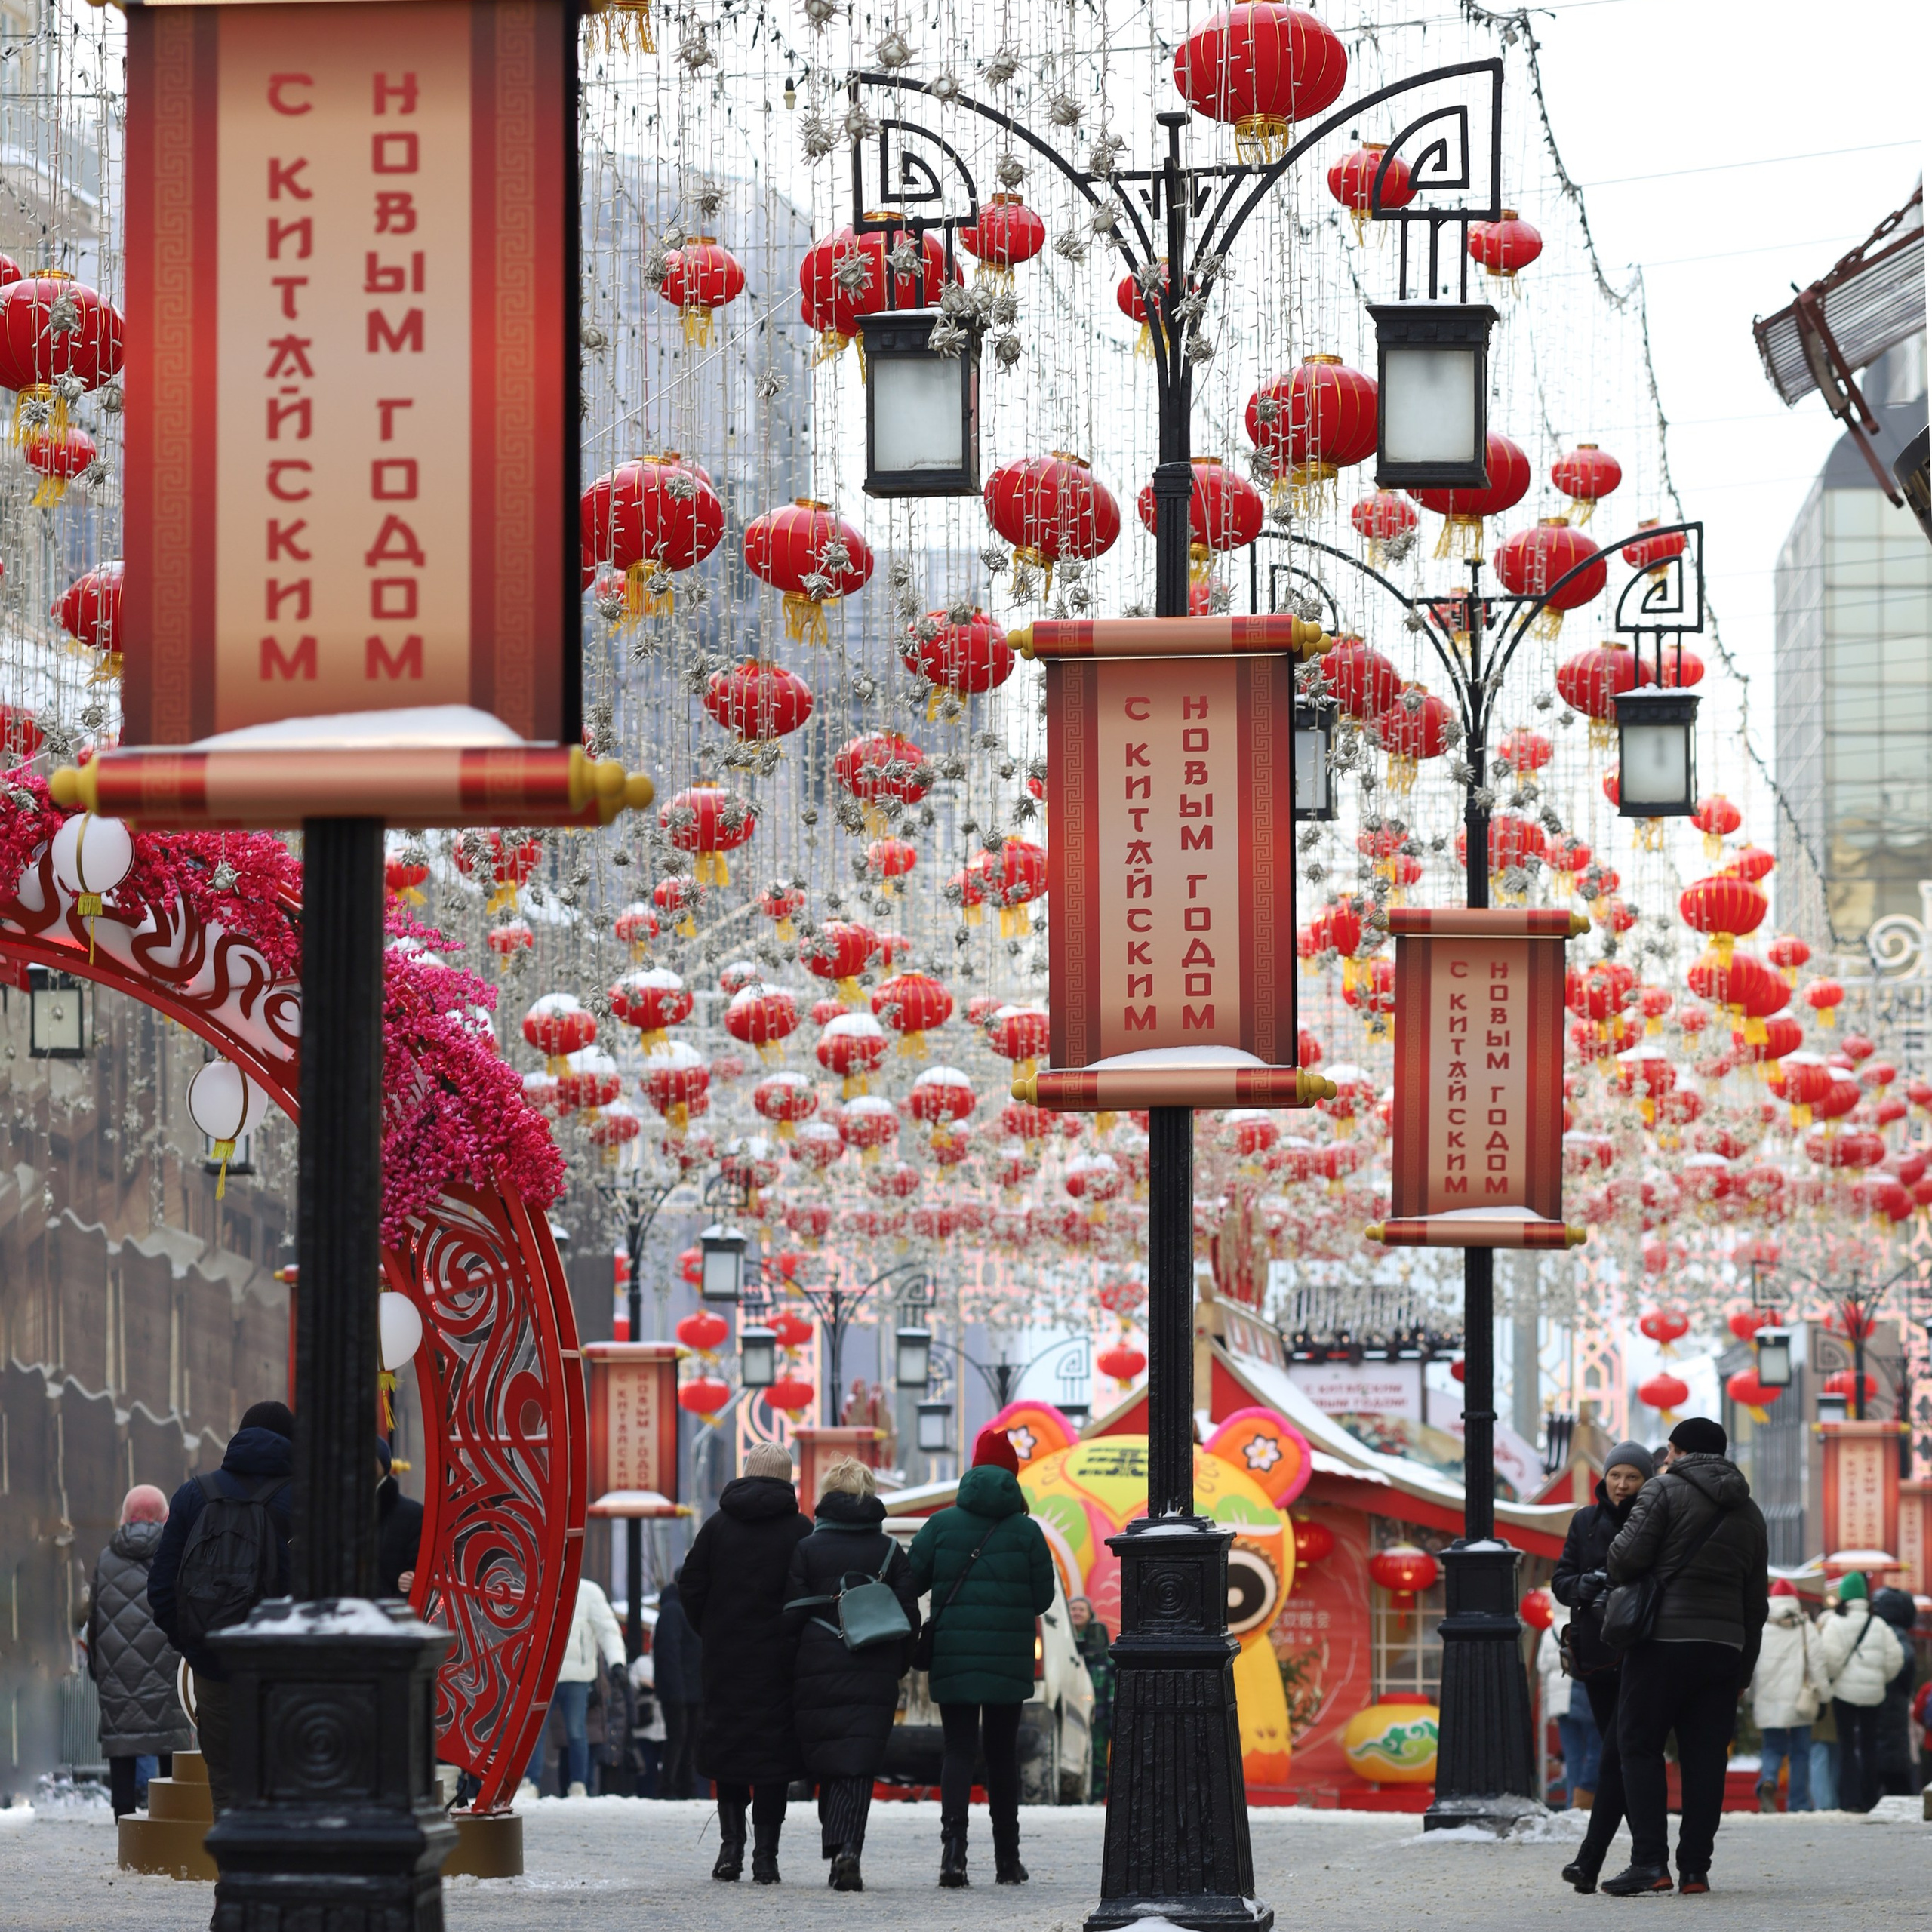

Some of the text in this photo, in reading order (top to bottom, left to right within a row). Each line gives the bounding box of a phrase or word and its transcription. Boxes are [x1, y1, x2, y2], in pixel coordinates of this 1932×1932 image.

[260, 73, 318, 681] С КИТАЙСКИМ
[363, 72, 426, 681] НОВЫМ ГОДОМ
[1124, 696, 1157, 1032] С КИТАЙСКИМ
[1178, 695, 1216, 1030] НОВЫМ ГОДОМ
[1444, 960, 1469, 1195] С КИТАЙСКИМ
[1484, 961, 1511, 1195] НОВЫМ ГОДОМ
